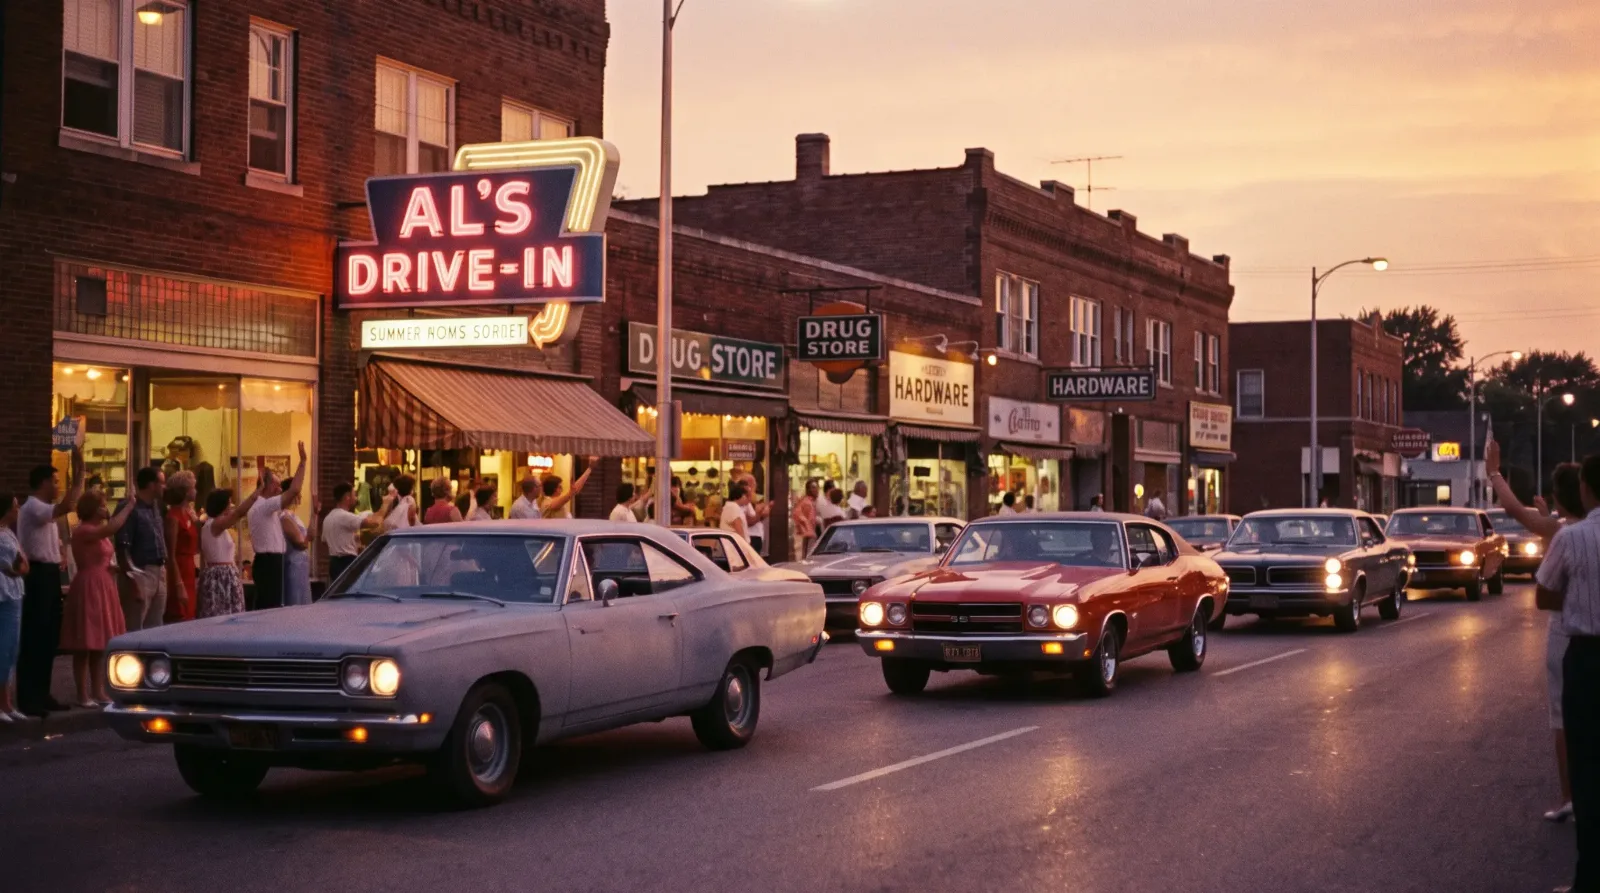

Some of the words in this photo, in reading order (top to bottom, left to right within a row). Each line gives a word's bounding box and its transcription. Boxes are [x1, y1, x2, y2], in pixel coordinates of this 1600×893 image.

[399, 178, 532, 238] AL'S
[348, 245, 573, 295] DRIVE-IN
[370, 326, 421, 341] SUMMER
[806, 319, 872, 339] DRUG
[639, 332, 701, 371] DUG
[711, 344, 776, 380] STORE
[807, 340, 870, 355] STORE
[895, 374, 969, 407] HARDWARE
[1052, 376, 1149, 395] HARDWARE
